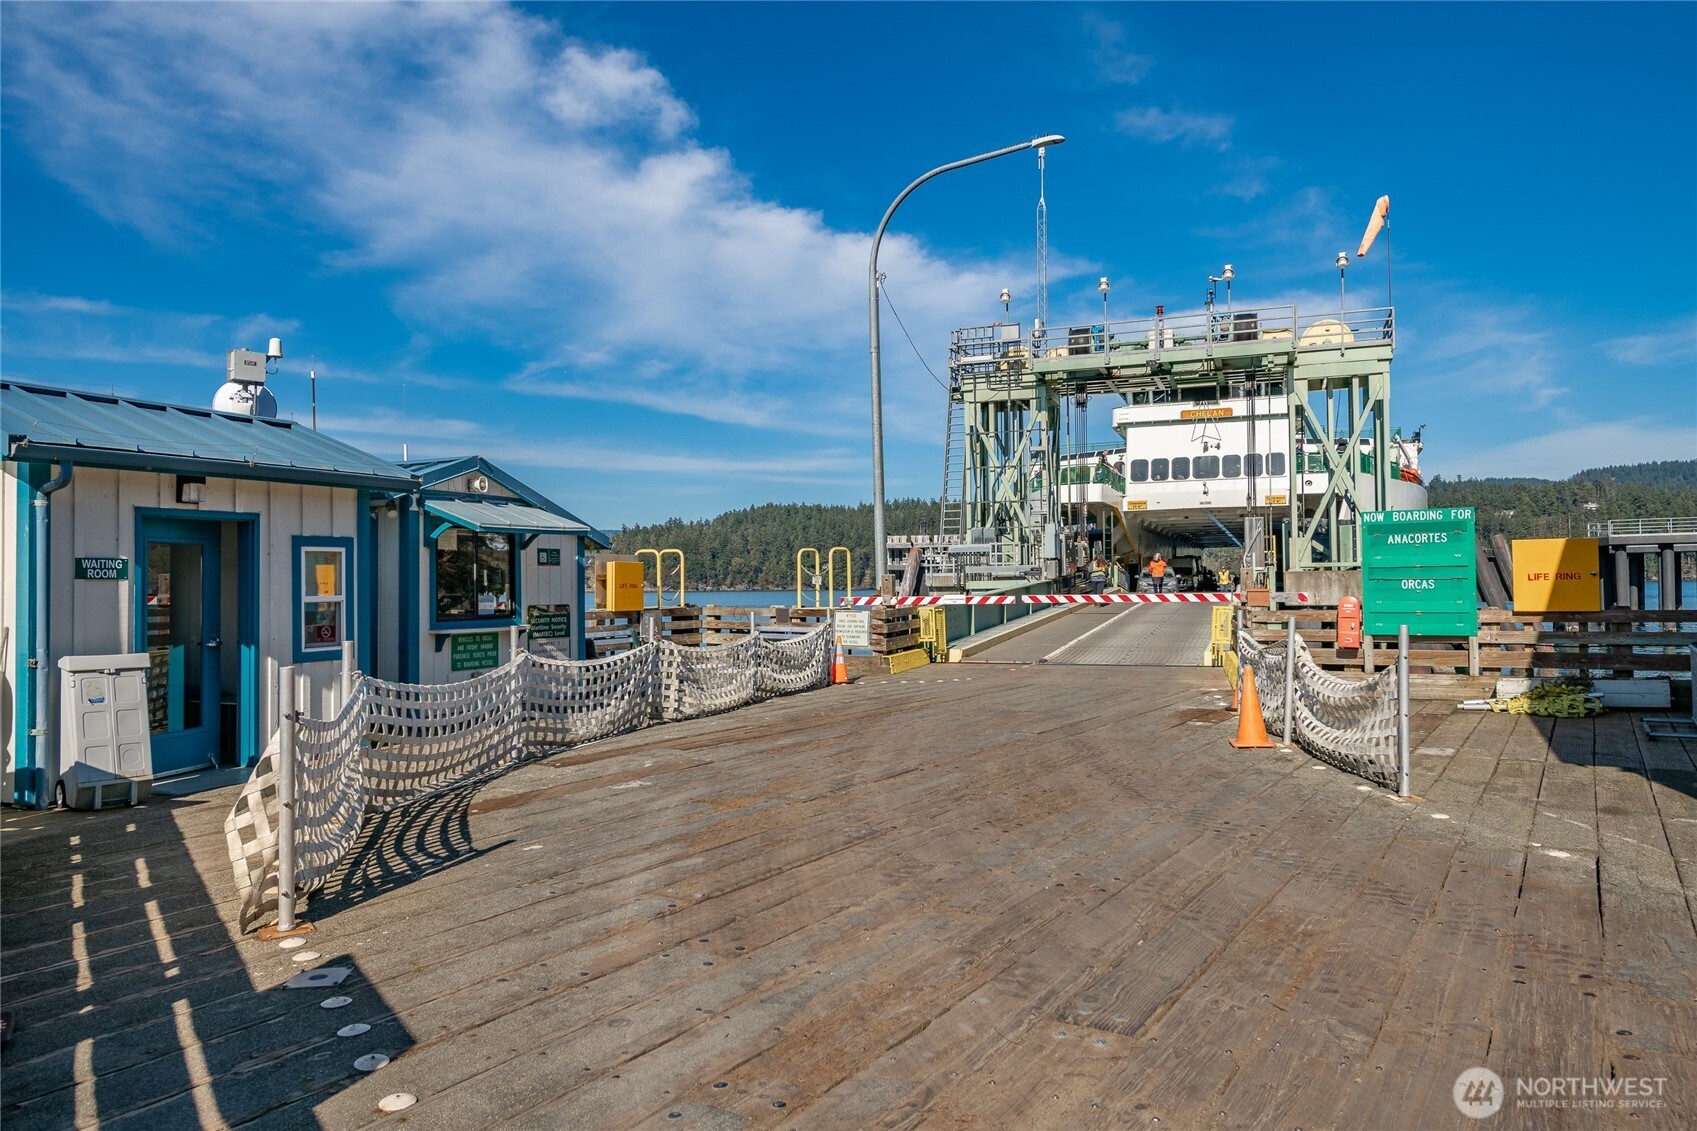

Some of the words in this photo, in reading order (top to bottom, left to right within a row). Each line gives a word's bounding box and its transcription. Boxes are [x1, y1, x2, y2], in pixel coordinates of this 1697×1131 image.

[1190, 409, 1224, 418] CHELAN
[1363, 512, 1385, 522] NOW
[1392, 510, 1443, 522] BOARDING
[1451, 509, 1471, 520] FOR
[1387, 532, 1448, 545] ANACORTES
[81, 559, 123, 569] WAITING
[87, 569, 117, 578] ROOM
[1527, 573, 1550, 581] LIFE
[1555, 572, 1582, 580] RING
[1401, 579, 1435, 590] ORCAS
